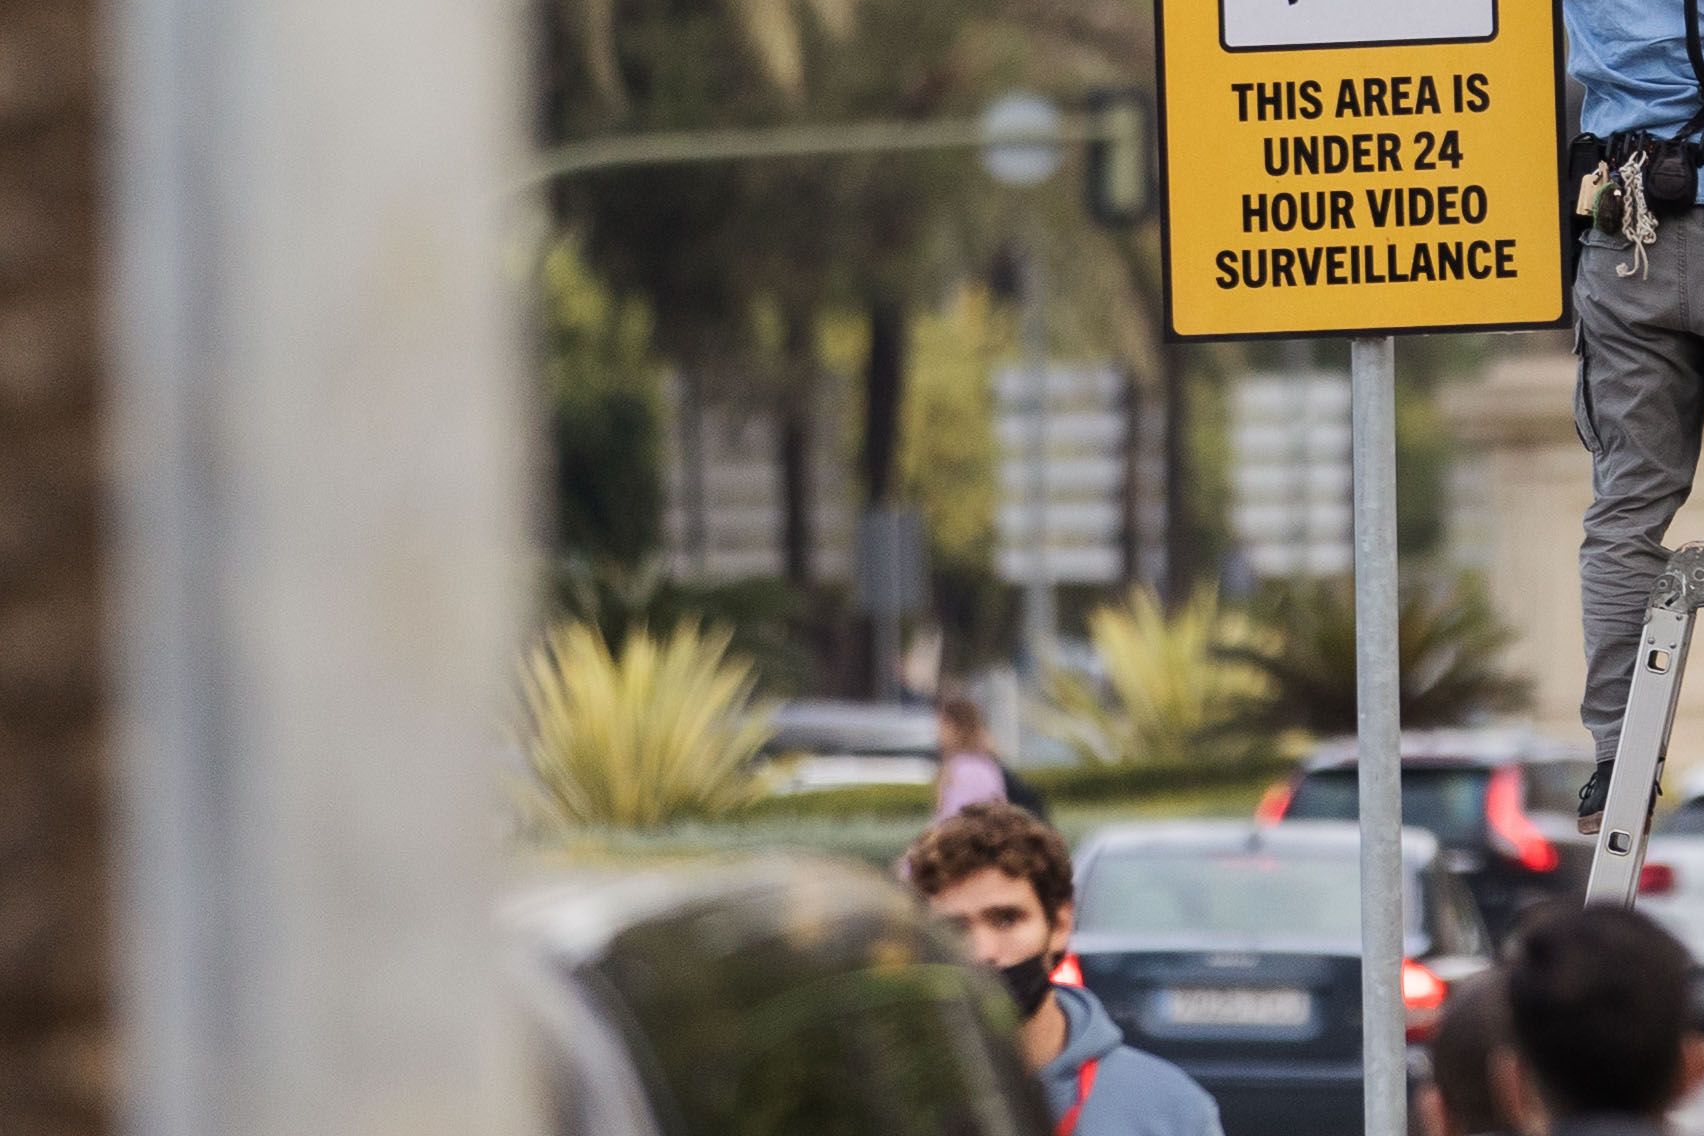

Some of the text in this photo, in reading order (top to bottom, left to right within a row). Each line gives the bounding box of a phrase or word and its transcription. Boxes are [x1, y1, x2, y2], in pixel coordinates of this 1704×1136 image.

[1231, 73, 1490, 122] THIS AREA IS
[1264, 130, 1463, 177] UNDER 24
[1242, 185, 1488, 233] HOUR VIDEO
[1215, 239, 1518, 290] SURVEILLANCE
